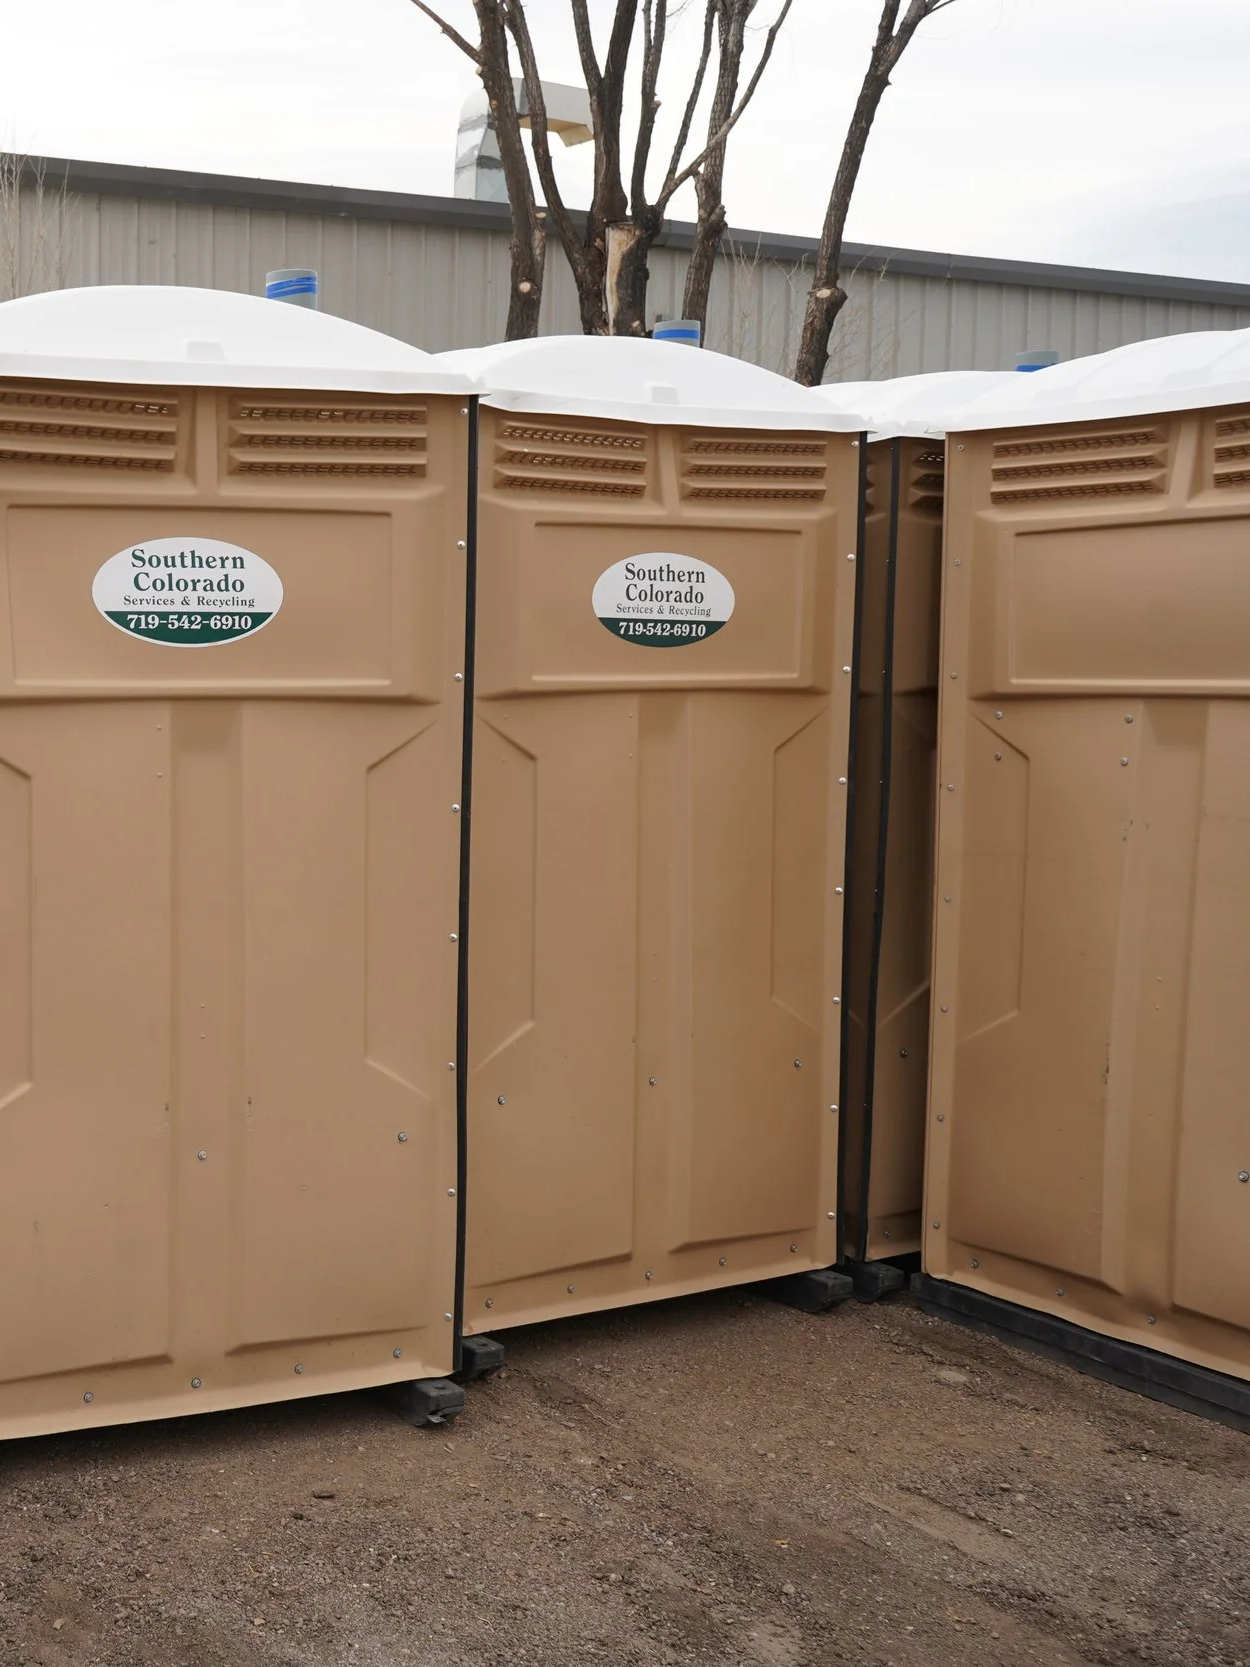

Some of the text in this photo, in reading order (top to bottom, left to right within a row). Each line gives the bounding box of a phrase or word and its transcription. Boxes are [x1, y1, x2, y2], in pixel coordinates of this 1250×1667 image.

[131, 548, 245, 569] Southern
[624, 562, 705, 583] Southern
[133, 572, 245, 592] Colorado
[123, 595, 255, 608] Services & Recycling
[625, 583, 704, 604] Colorado
[616, 603, 712, 618] Services & Recycling
[126, 614, 252, 629] 719-542-6910
[619, 621, 706, 637] 719-542-6910
